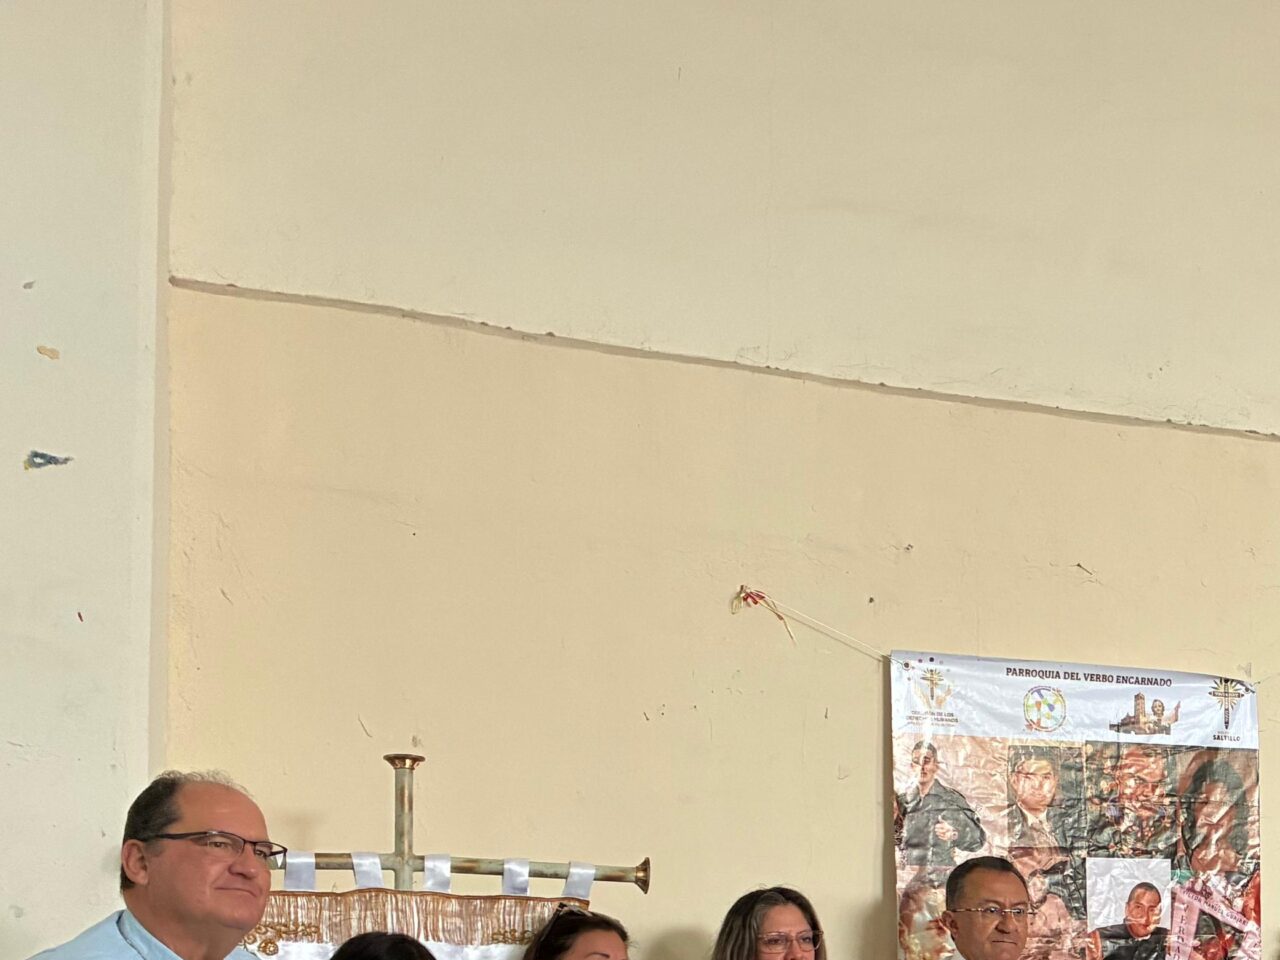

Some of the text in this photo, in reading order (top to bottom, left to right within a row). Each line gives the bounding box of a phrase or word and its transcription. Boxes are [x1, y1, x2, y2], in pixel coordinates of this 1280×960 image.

[1006, 667, 1172, 687] PARROQUIA DEL VERBO ENCARNADO
[1213, 734, 1241, 742] SALTILLO
